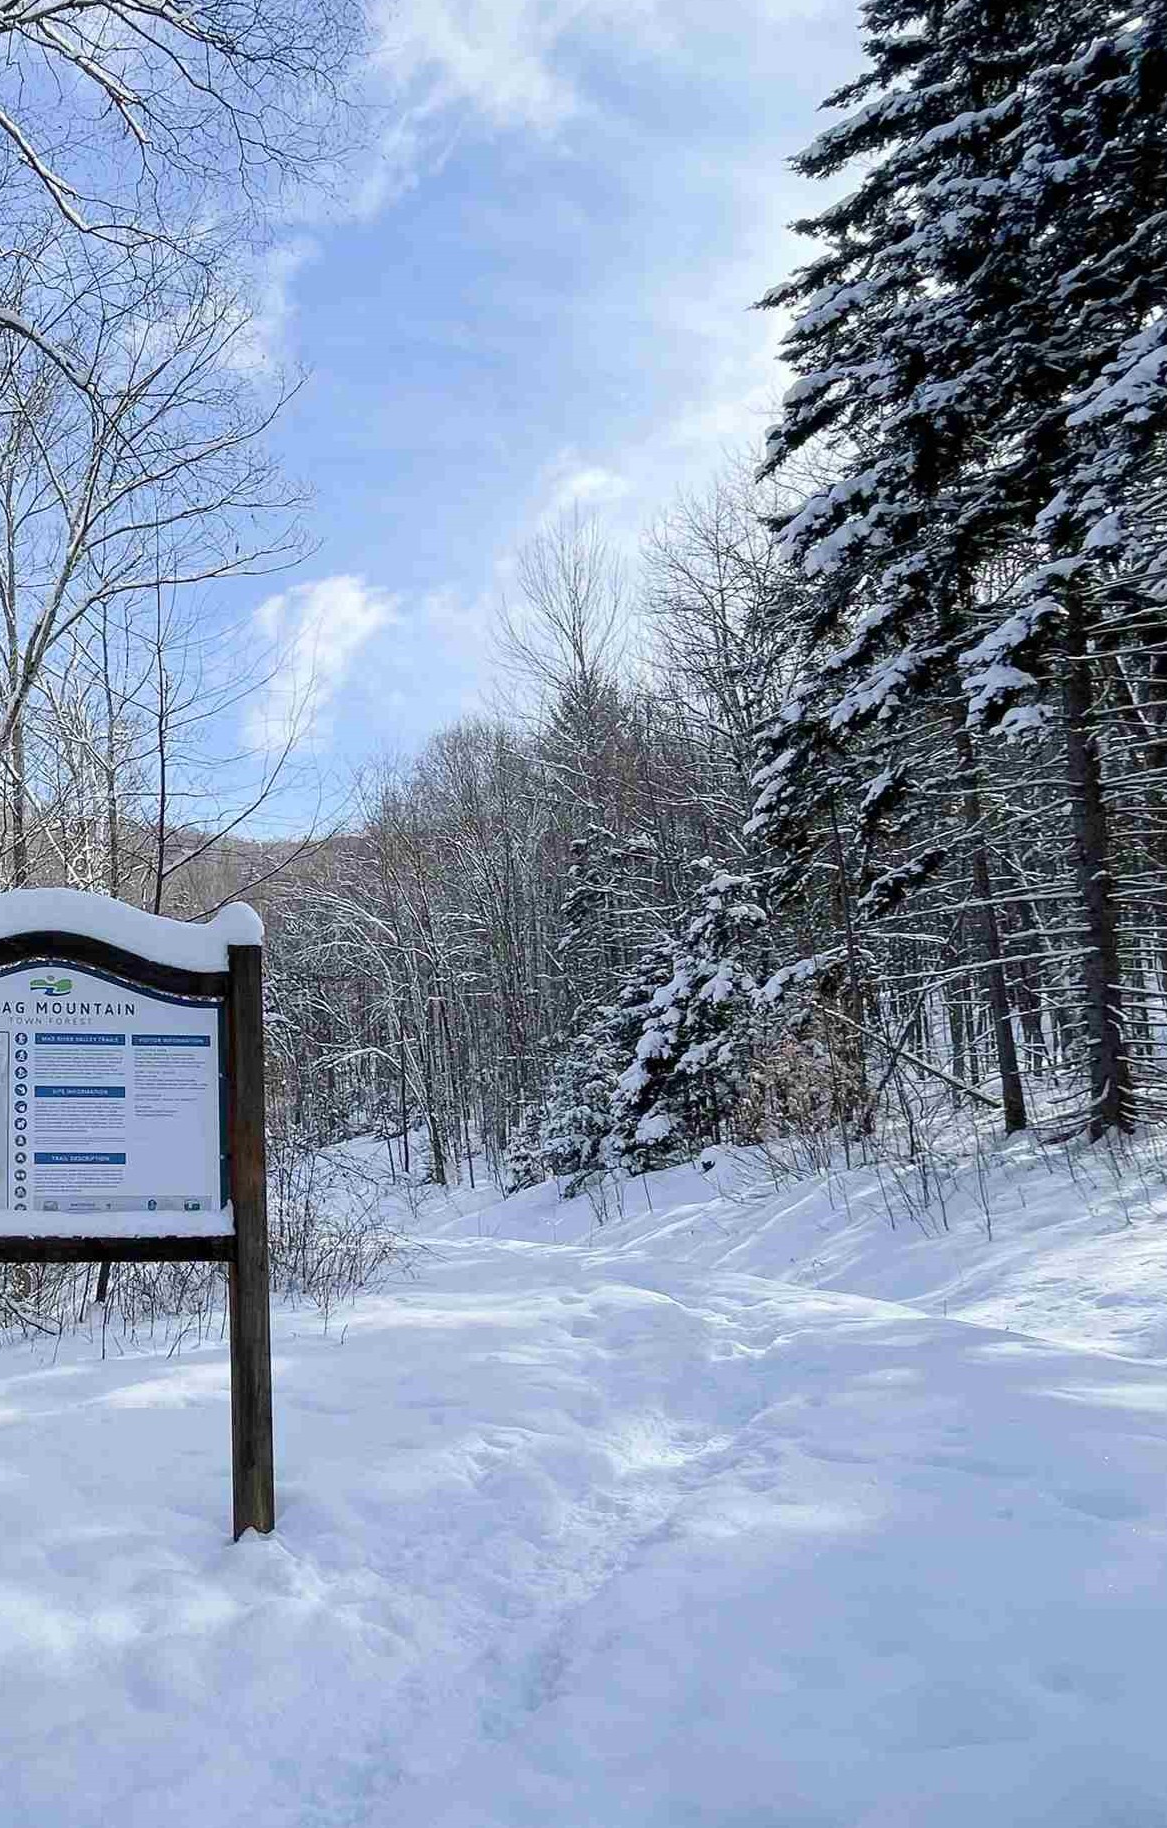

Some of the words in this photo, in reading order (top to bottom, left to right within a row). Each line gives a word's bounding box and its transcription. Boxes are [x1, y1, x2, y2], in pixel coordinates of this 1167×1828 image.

[36, 1002, 135, 1015] MOUNTAIN
[9, 1017, 42, 1025] TOWN
[49, 1017, 92, 1025] FOREST
